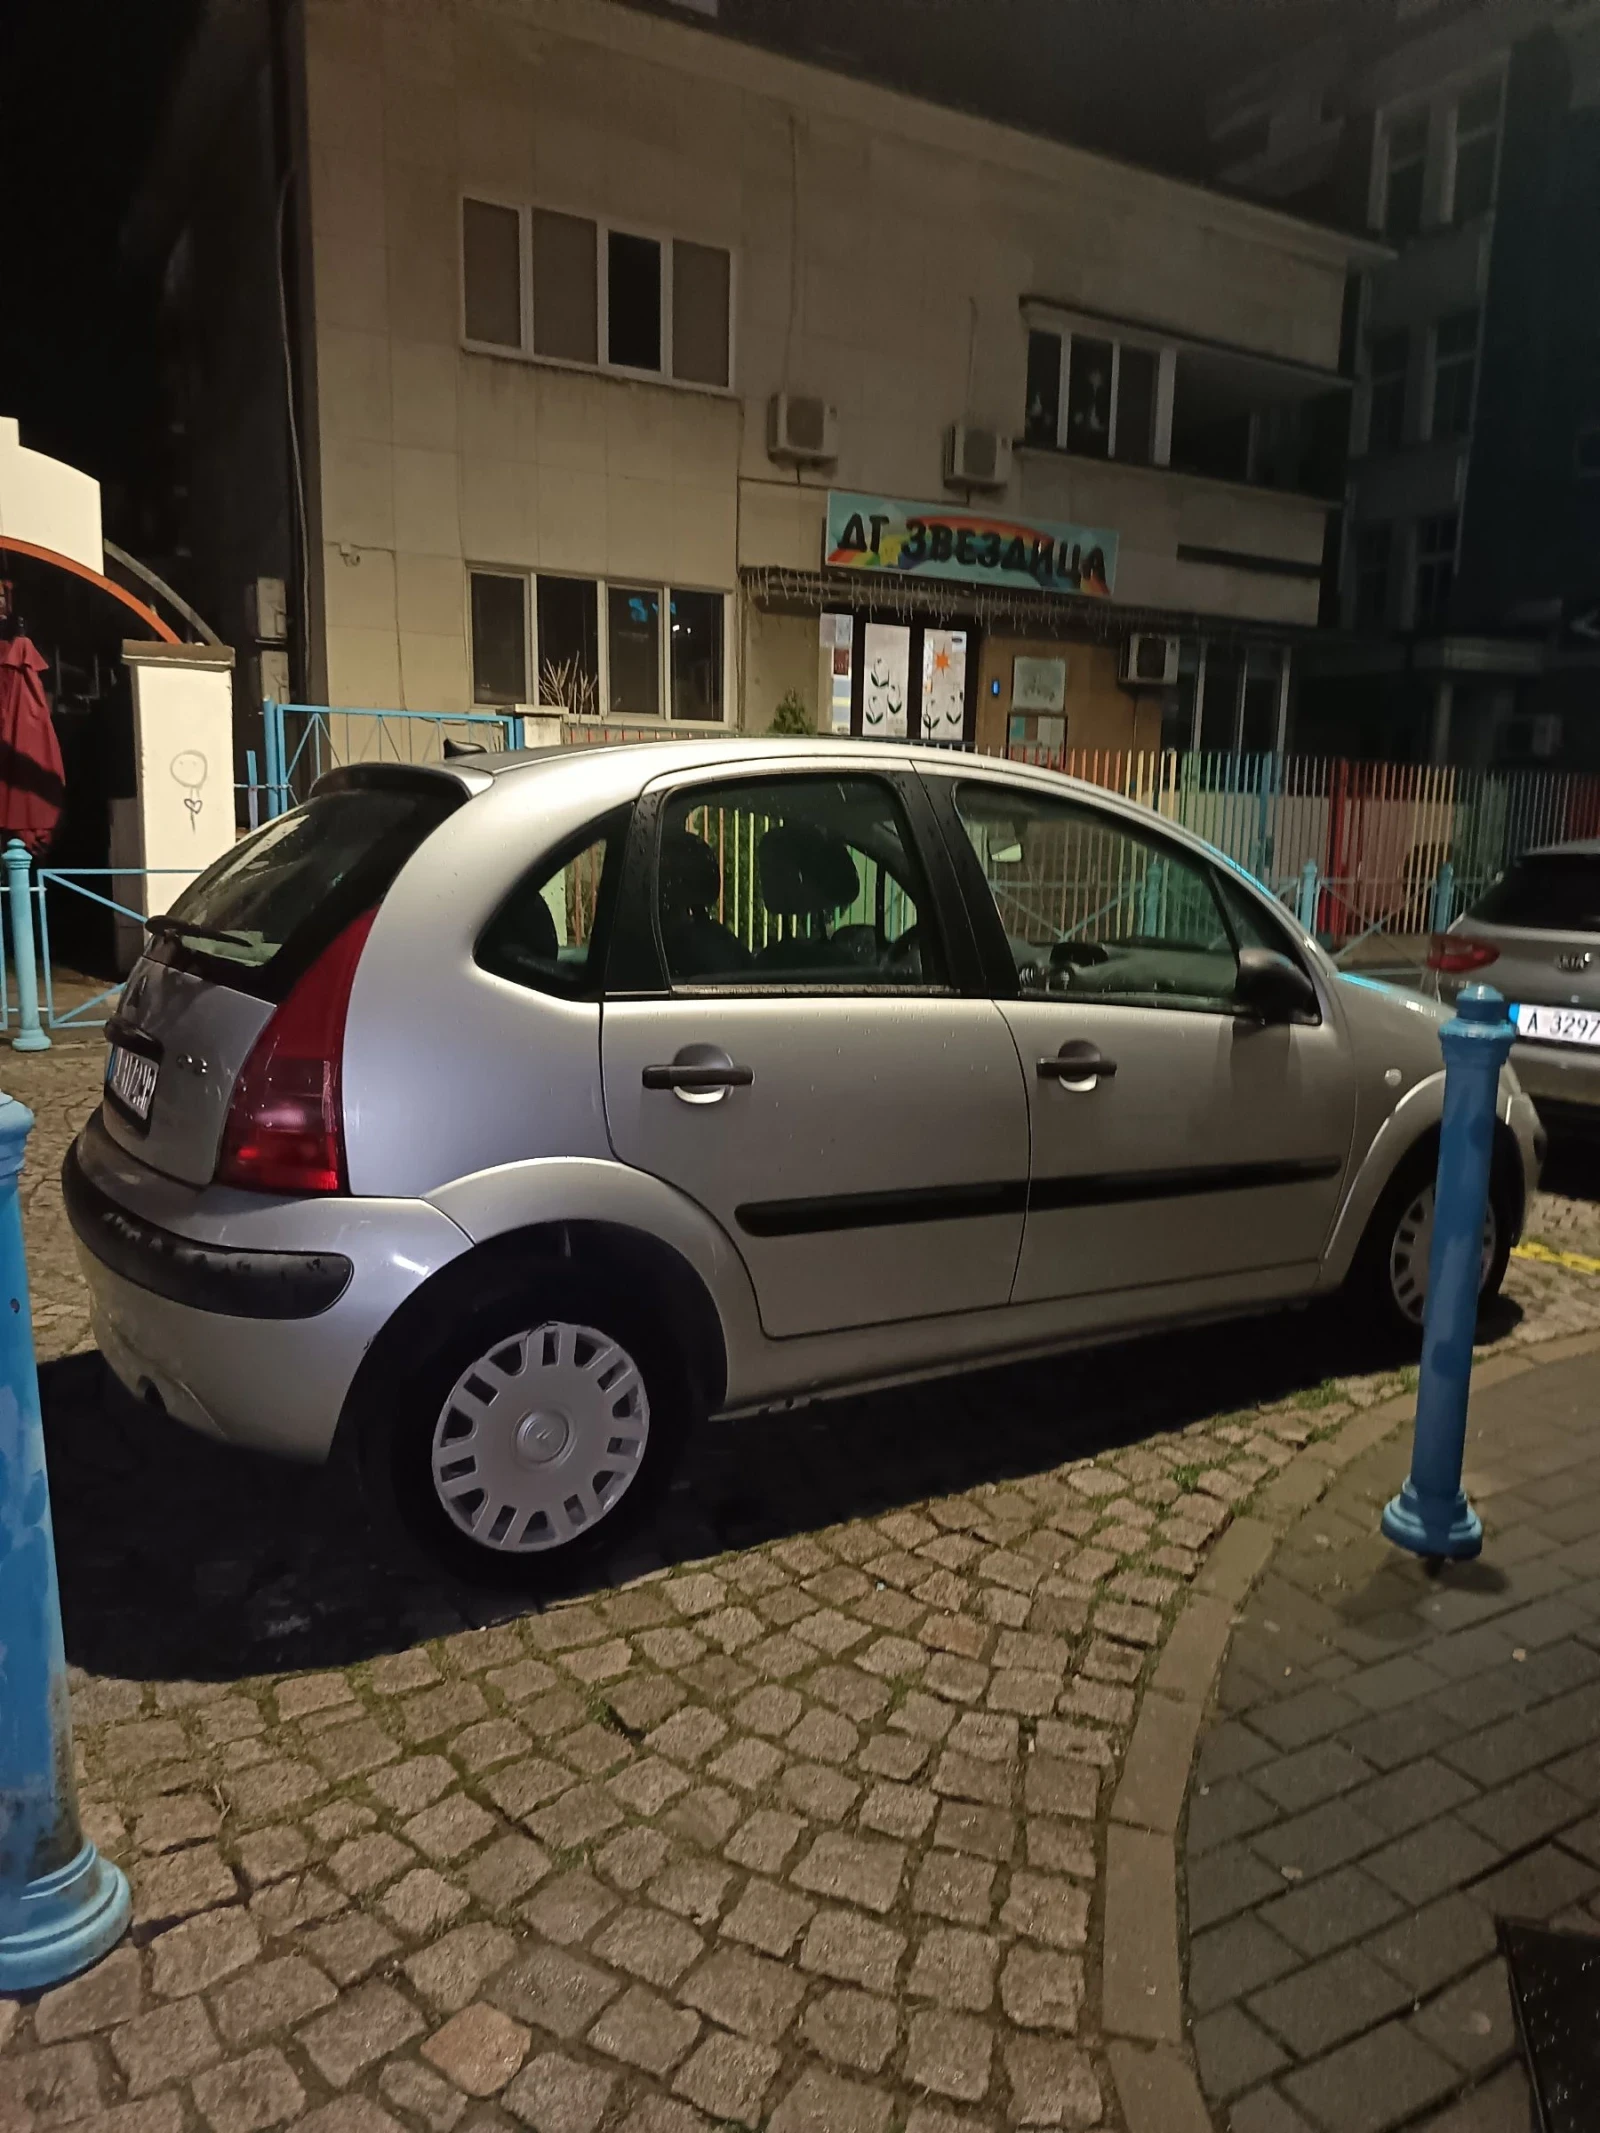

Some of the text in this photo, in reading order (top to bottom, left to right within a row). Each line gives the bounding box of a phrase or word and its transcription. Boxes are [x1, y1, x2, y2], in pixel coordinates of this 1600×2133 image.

[837, 512, 1107, 589] ДГ ЗВЕЗДИЦА
[1526, 1008, 1538, 1034] A
